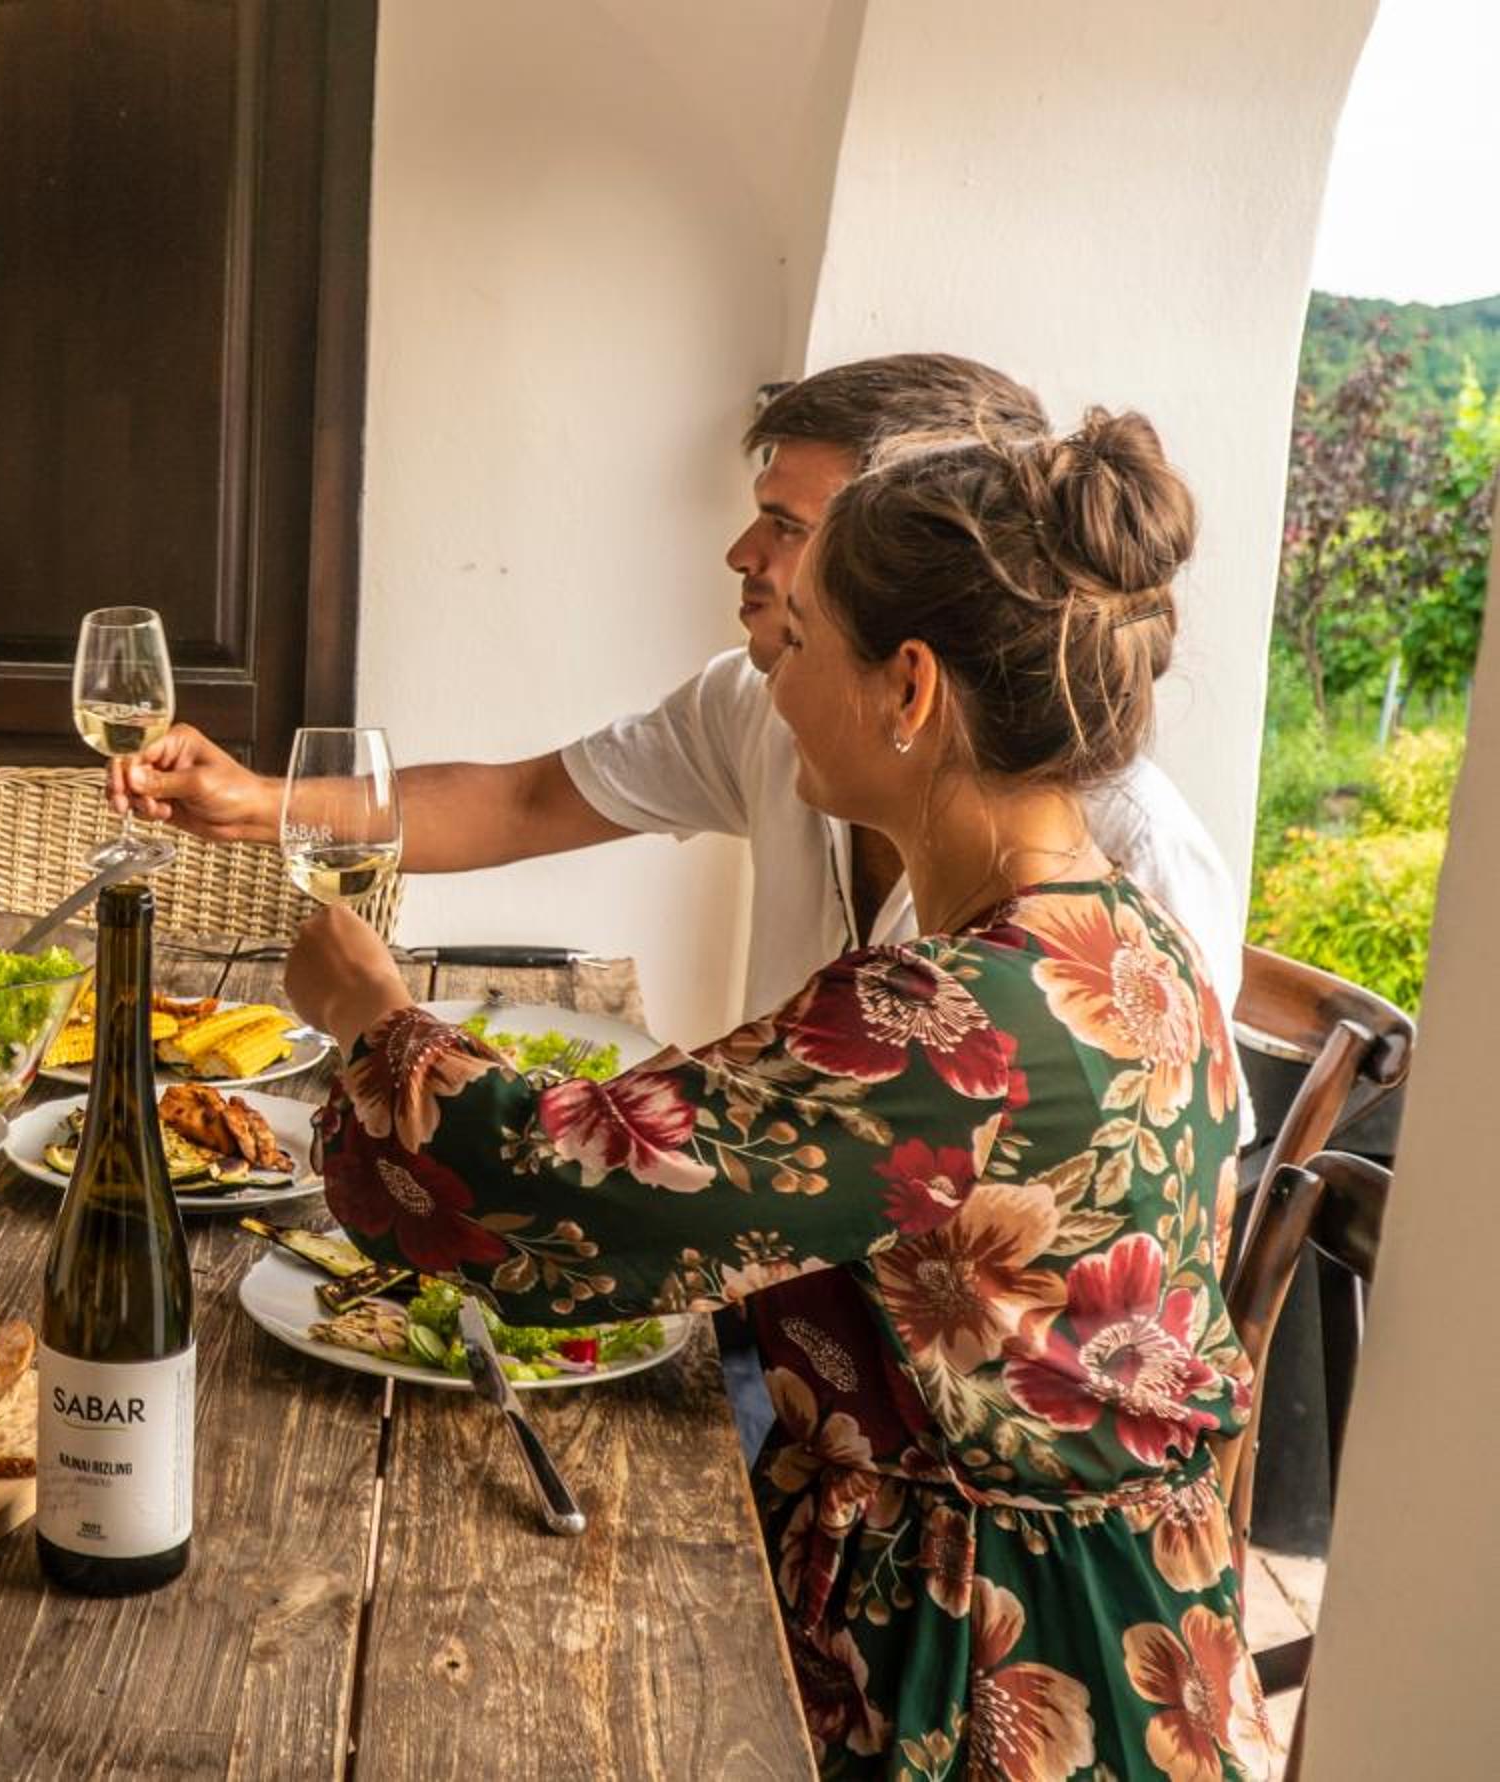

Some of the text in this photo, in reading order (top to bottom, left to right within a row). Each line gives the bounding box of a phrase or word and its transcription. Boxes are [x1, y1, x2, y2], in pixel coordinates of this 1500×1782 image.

[283, 823, 333, 843] SABAR
[53, 1387, 146, 1423] SABAR
[92, 1460, 133, 1476] RIZLING
